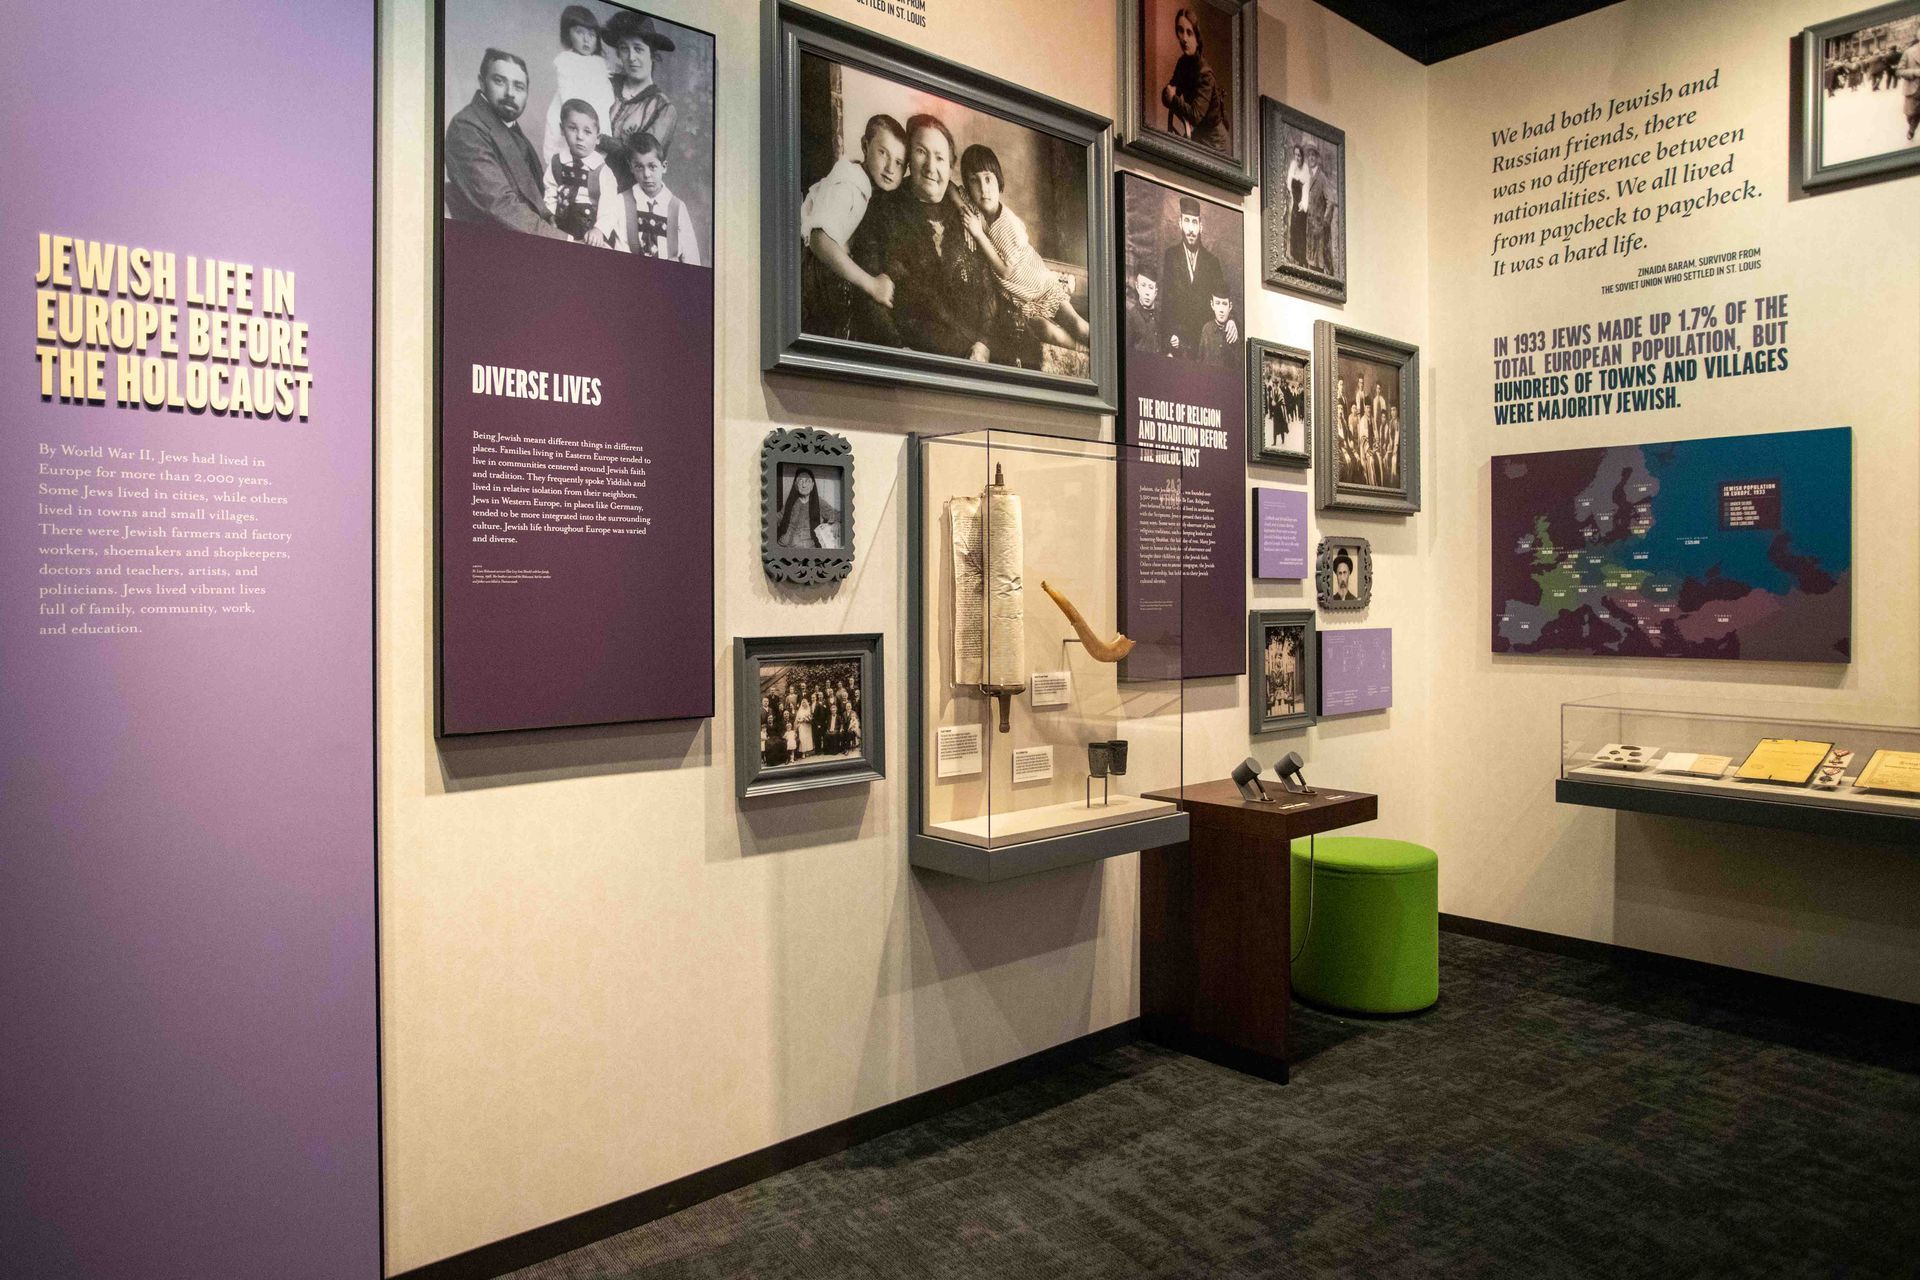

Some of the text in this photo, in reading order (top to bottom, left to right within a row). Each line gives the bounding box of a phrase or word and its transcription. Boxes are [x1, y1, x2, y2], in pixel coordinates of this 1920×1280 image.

[887, 3, 895, 16] IN
[907, 10, 926, 28] LOUIS
[1492, 69, 1719, 147] We had both Jewish and
[1492, 110, 1696, 173] Russian friends, there
[1493, 128, 1744, 199] was no difference between
[1493, 154, 1734, 224] nationalities. We all lived
[1490, 182, 1762, 256] from paycheck to paycheck.
[35, 233, 294, 315] JEWISH LIFE IN
[1493, 232, 1647, 276] It was a hard life.
[1637, 264, 1666, 277] ZINAIDA
[1698, 251, 1736, 266] SURVIVOR
[1738, 247, 1760, 259] FROM
[1601, 259, 1761, 294] THE SOVIET UNION WHO SETTLED IN ST. LOUIS
[36, 289, 308, 366] EUROPE BEFORE
[1494, 294, 1788, 357] IN 1933 JEWS MADE UP 1.7% OF THE
[1493, 320, 1788, 380] TOTAL EUROPEAN POPULATION, BUT
[36, 345, 313, 416] THE HOLOCAUST
[472, 364, 601, 406] DIVERSE LIVES
[1494, 347, 1788, 403] HUNDREDS OF TOWNS AND VILLAGES
[1138, 397, 1220, 427] THE ROLE OF RELIGION
[1494, 386, 1681, 425] WERE MAJORITY JEWISH.
[1138, 420, 1227, 449] AND TRADITION BEFORE
[1138, 442, 1154, 462] THE
[39, 443, 56, 458] By
[60, 444, 103, 457] World
[107, 447, 135, 459] War
[158, 450, 188, 464] Jews
[192, 452, 215, 464] had
[219, 453, 248, 466] lived
[252, 457, 265, 467] in
[38, 483, 288, 504] Some Jews lived in cities, while others
[39, 503, 258, 524] lived in towns and small villages.
[38, 523, 292, 543] There were Jewish farmers and factory
[39, 583, 266, 598] politicians. Jews lived vibrant lives
[39, 622, 142, 634] and education.
